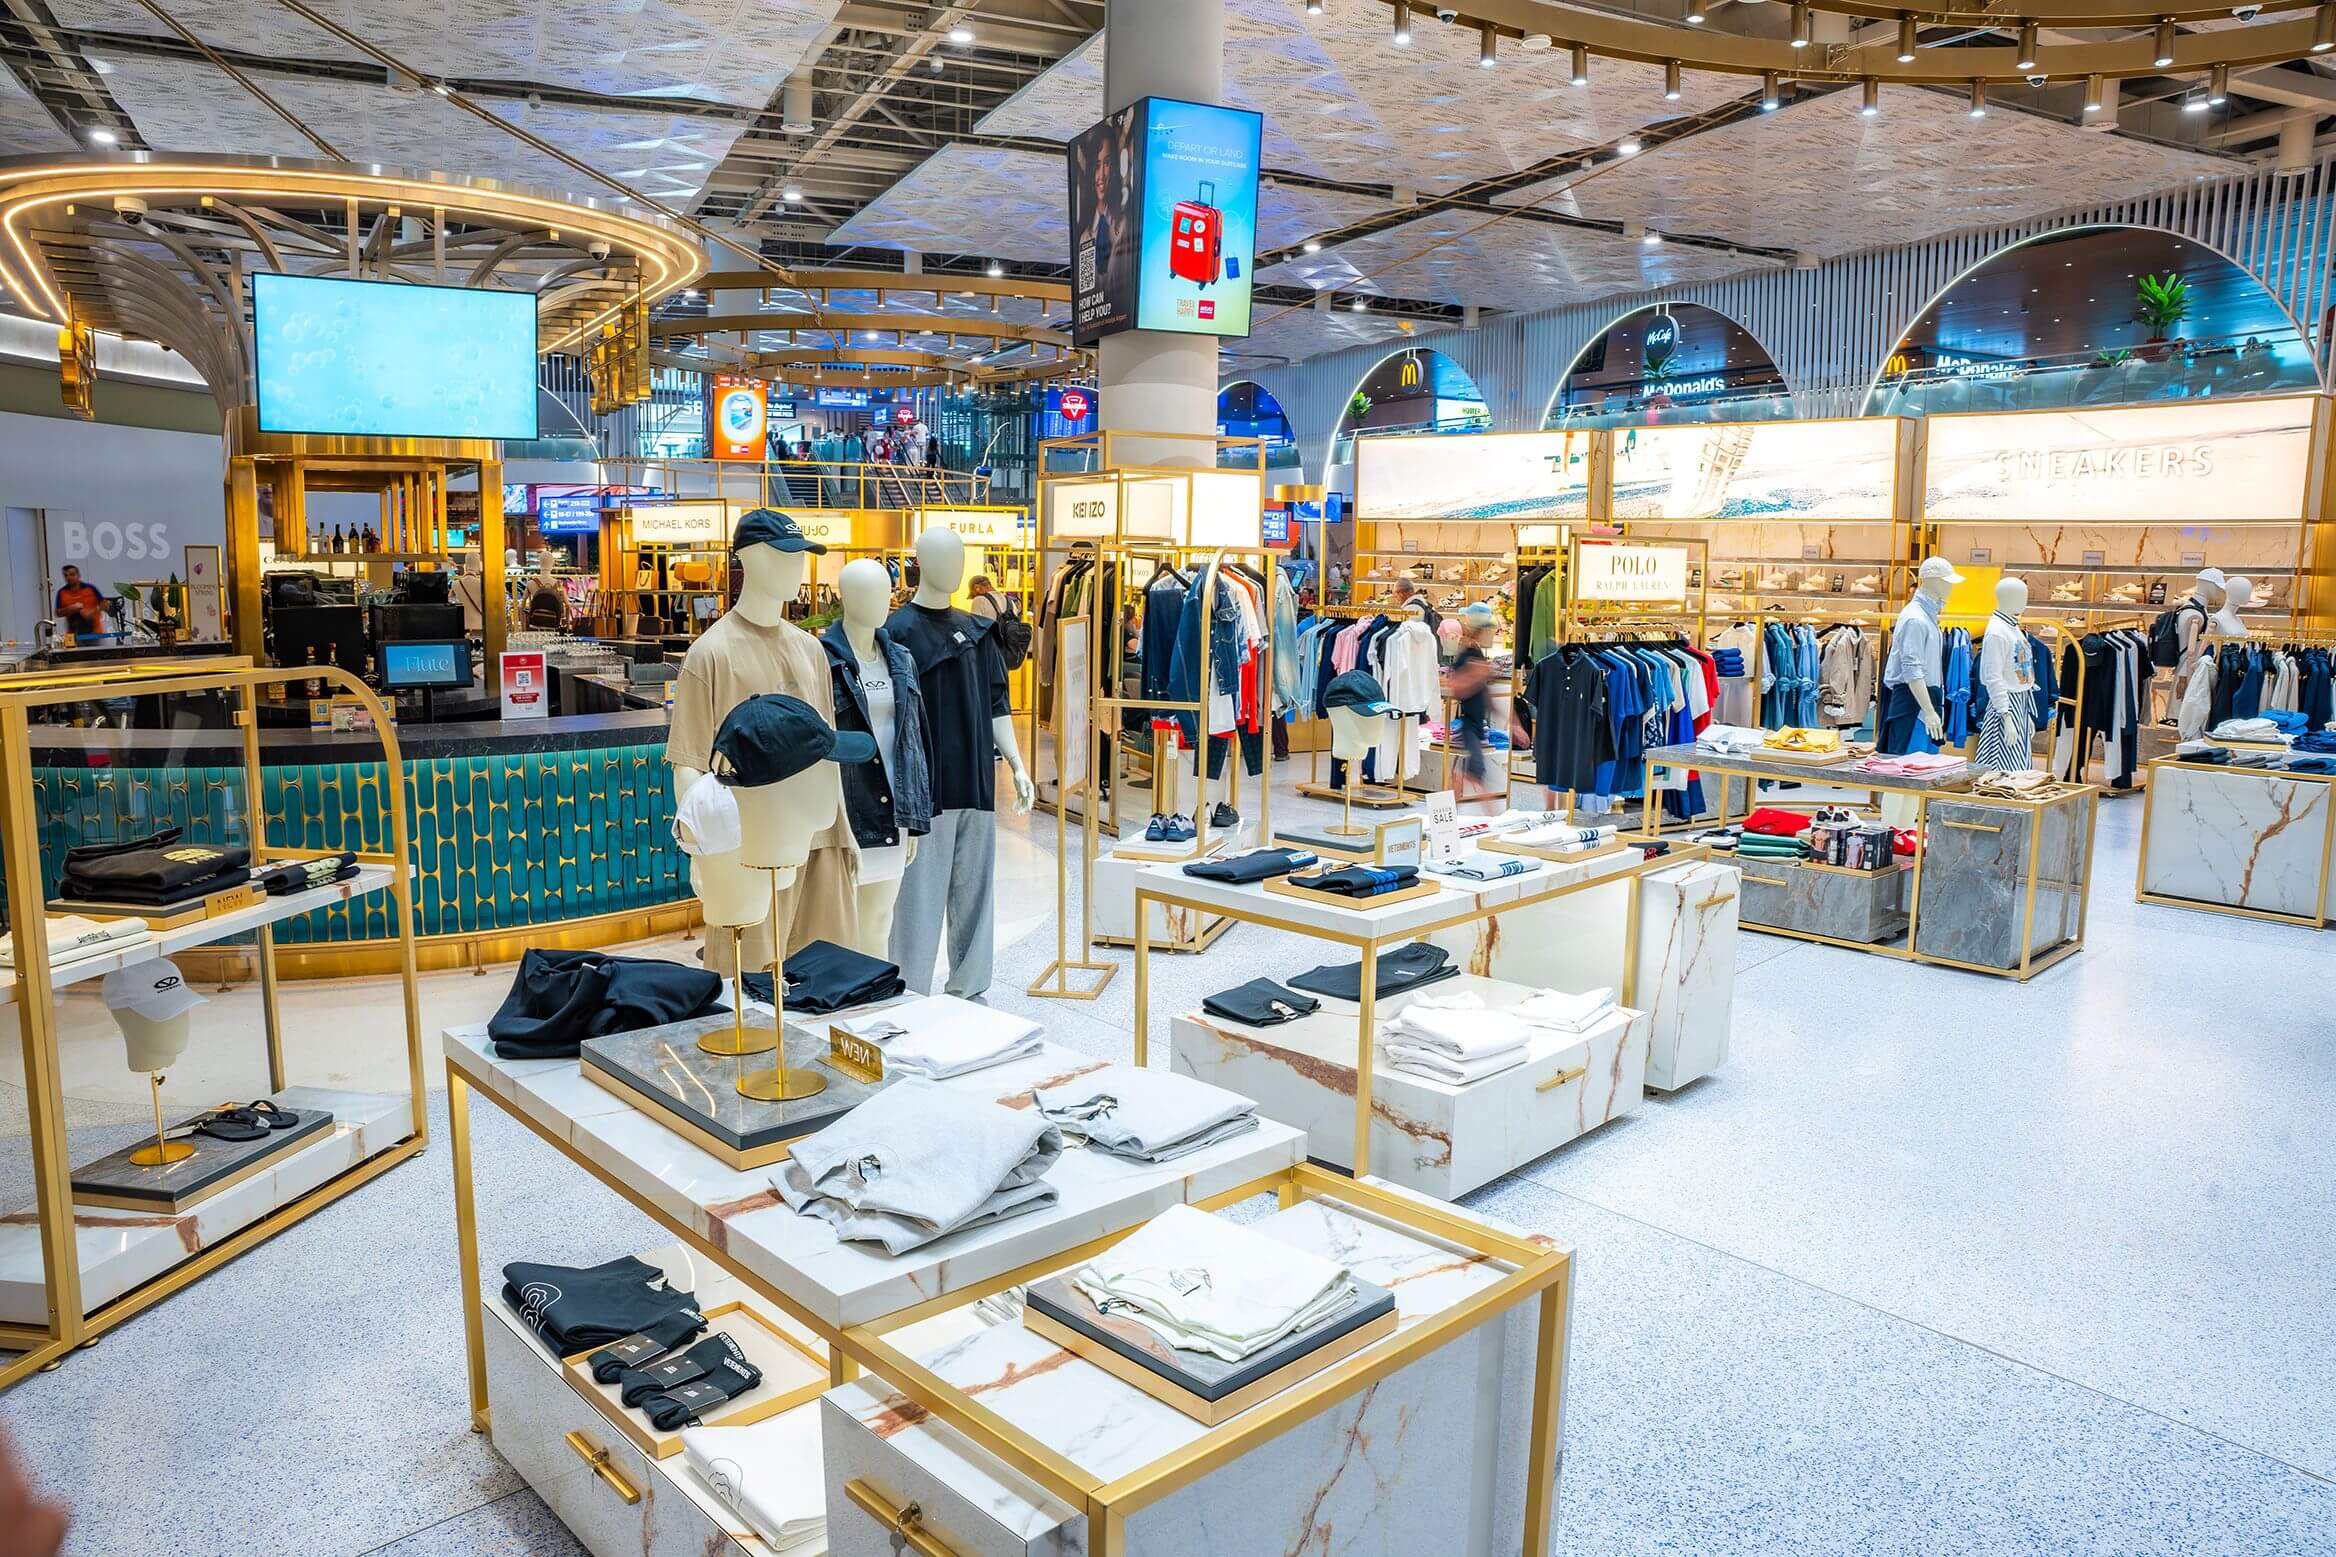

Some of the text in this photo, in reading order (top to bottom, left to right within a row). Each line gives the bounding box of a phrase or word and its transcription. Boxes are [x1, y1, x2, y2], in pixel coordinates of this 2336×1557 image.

[1167, 140, 1201, 153] DEPART
[1219, 146, 1244, 159] LAND
[1079, 290, 1105, 311] HOW CAN
[1081, 307, 1094, 323] HELP
[1095, 302, 1112, 318] YOU?
[1642, 376, 1726, 399] McDonald's
[1995, 445, 2214, 482] SNEAKERS
[1072, 500, 1106, 519] KENZO
[642, 518, 711, 529] MICHAEL KORS
[949, 522, 994, 534] FURLA
[63, 521, 171, 560] BOSS
[1611, 554, 1657, 576] POLO
[1596, 580, 1670, 593] RALPH LAUREN
[406, 655, 449, 673] Flute
[1432, 811, 1454, 825] SALE
[217, 892, 243, 911] NEW
